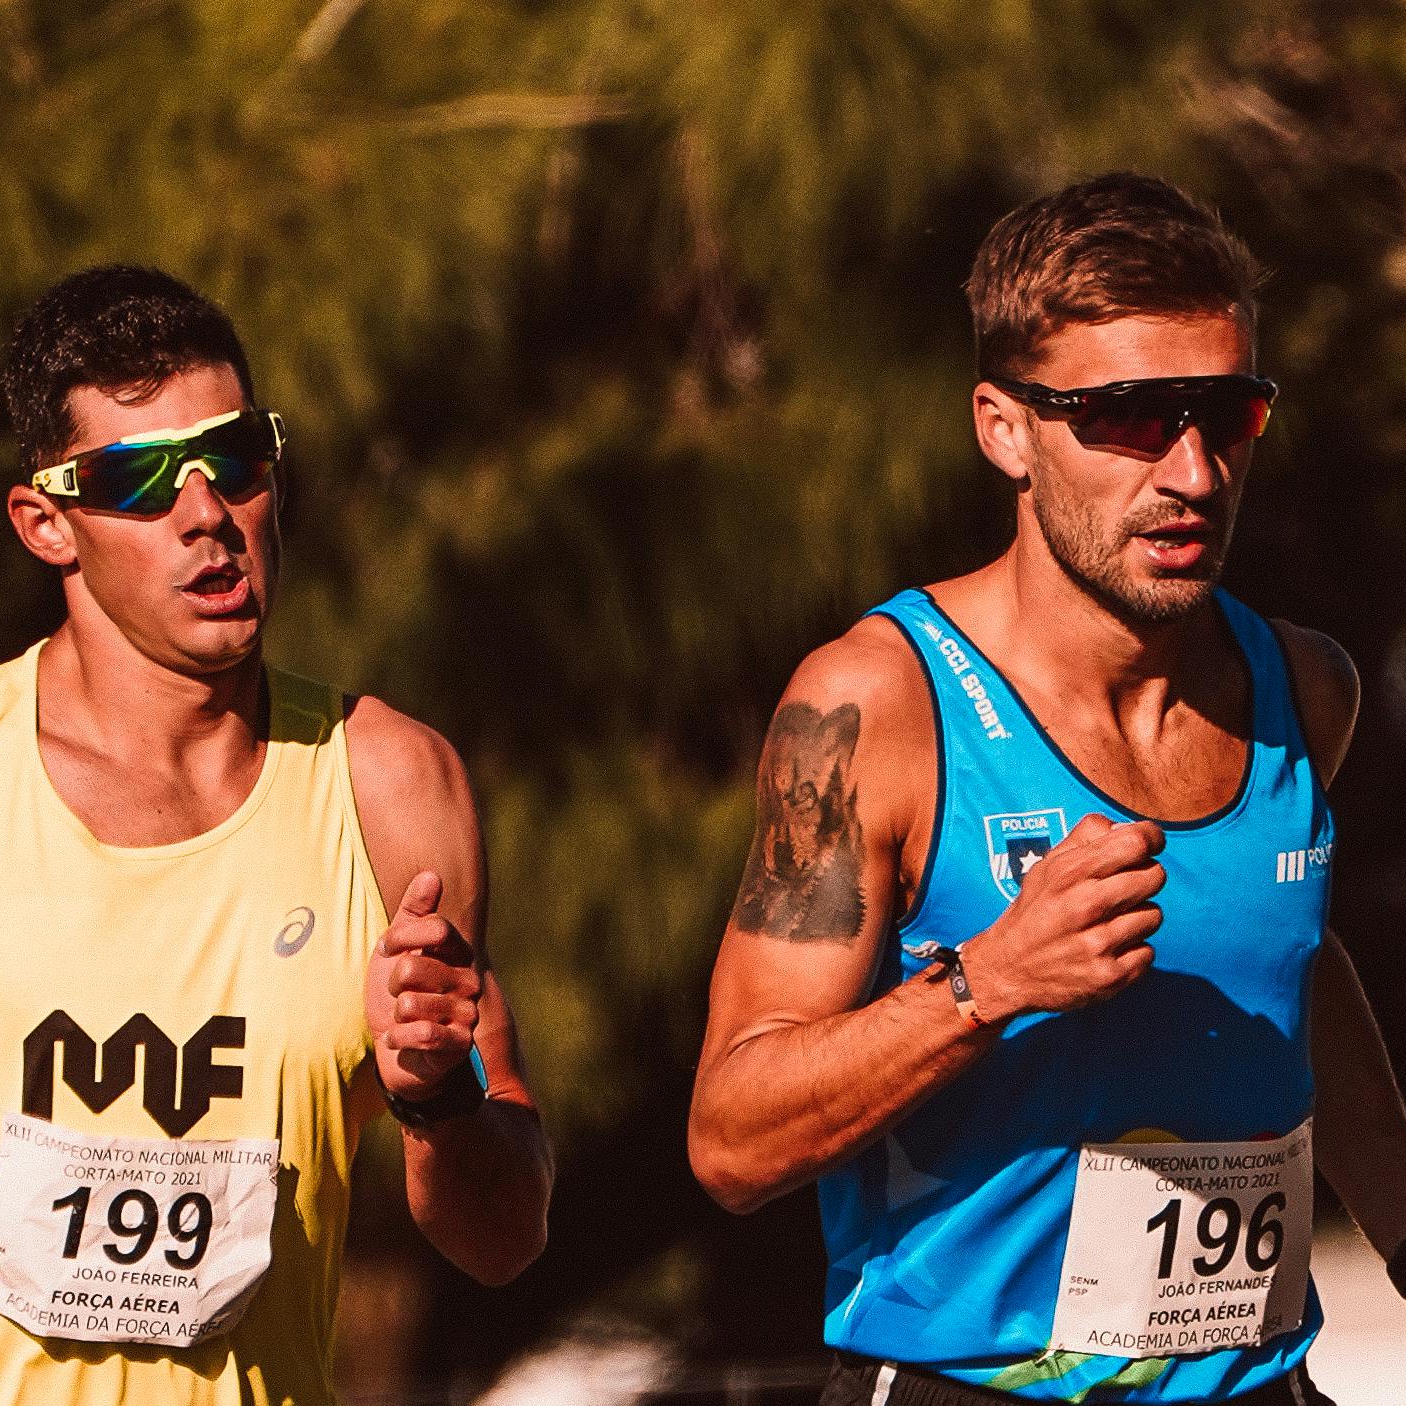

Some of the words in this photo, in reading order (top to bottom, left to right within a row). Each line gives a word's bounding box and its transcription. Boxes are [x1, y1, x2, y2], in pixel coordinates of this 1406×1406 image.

[939, 638, 971, 675] CCI
[961, 673, 1007, 740] SPORT
[35, 1132, 134, 1163] CAMPEONATO
[139, 1151, 209, 1166] NACIONAL
[213, 1150, 274, 1167] MILITAR
[1083, 1157, 1114, 1172] XLII
[1120, 1156, 1220, 1172] CAMPEONATO
[1222, 1152, 1285, 1169] NACIONAL
[63, 1164, 166, 1185] CORTA-MATO
[171, 1171, 201, 1186] 2021
[1156, 1176, 1248, 1191] CORTA-MATO
[1251, 1172, 1281, 1188] 2021
[52, 1185, 213, 1271] 199
[1146, 1191, 1287, 1279] 196
[121, 1271, 199, 1289] FERREIRA
[1158, 1281, 1195, 1299] JOÃO
[51, 1290, 114, 1312] FORÇA
[120, 1292, 180, 1314] AÉREA
[1148, 1307, 1201, 1327] FORÇA
[1205, 1301, 1256, 1322] AÉREA
[5, 1292, 79, 1329] ACADEMIA
[86, 1315, 109, 1332] DA
[116, 1317, 170, 1339] FORÇA
[1087, 1330, 1173, 1350] ACADEMIA
[1178, 1331, 1197, 1347] DA
[1202, 1325, 1248, 1346] FORÇA
